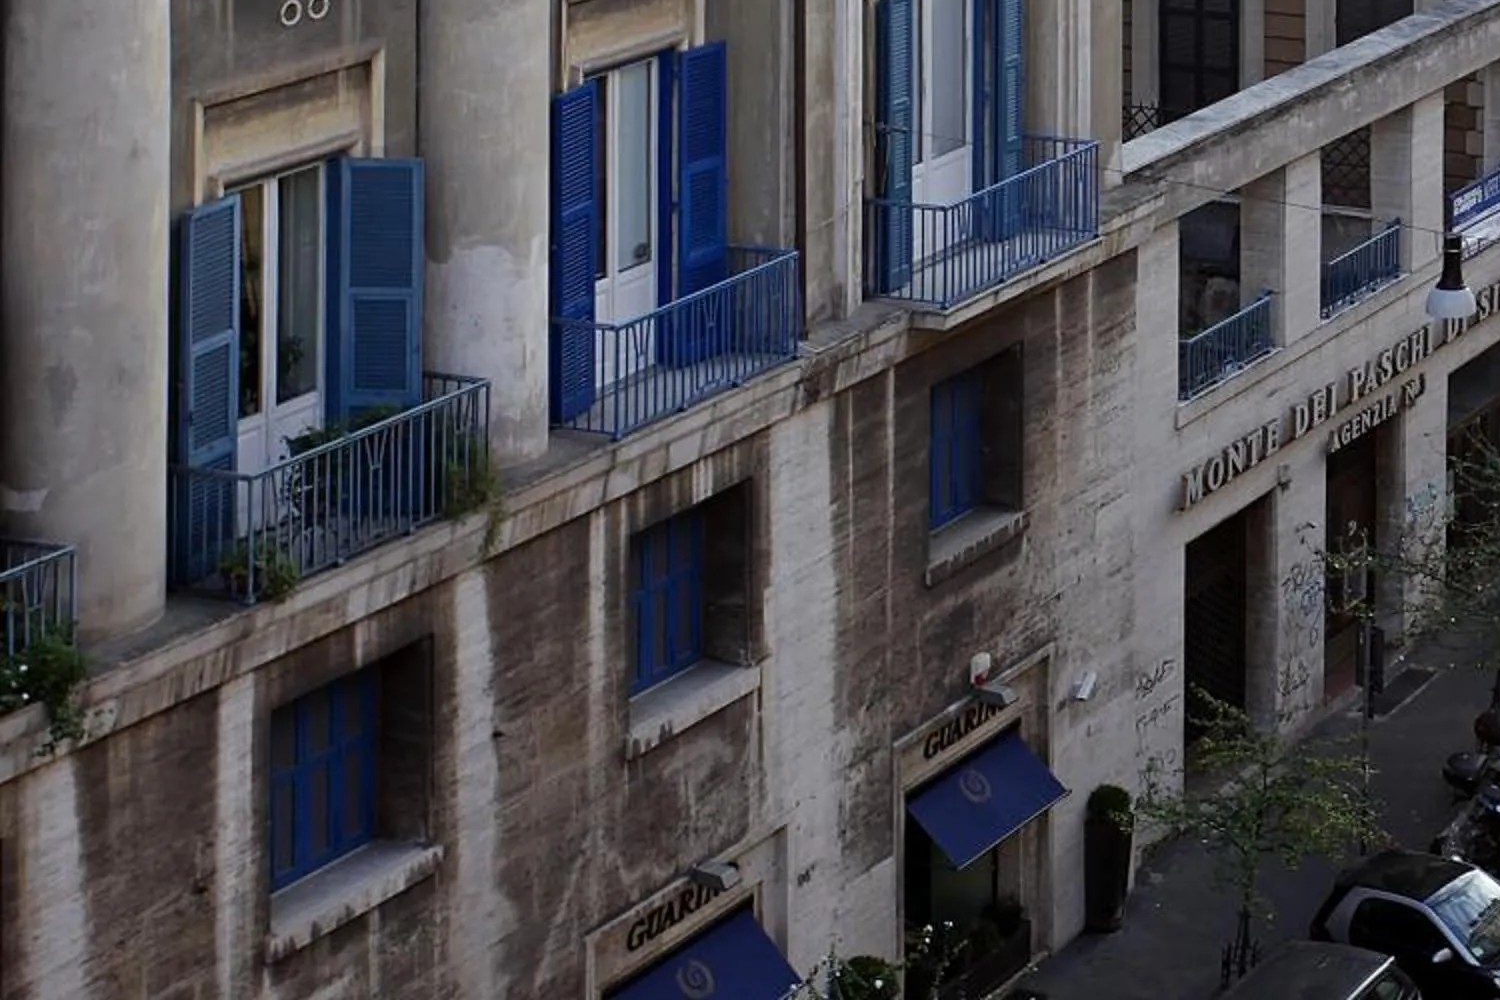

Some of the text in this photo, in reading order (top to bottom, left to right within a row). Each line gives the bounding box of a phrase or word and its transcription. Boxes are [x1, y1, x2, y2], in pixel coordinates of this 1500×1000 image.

[1183, 418, 1280, 508] MONTE
[1292, 382, 1338, 439] DEI
[1350, 323, 1433, 402] PASCHI
[1327, 396, 1397, 453] AGENZIA
